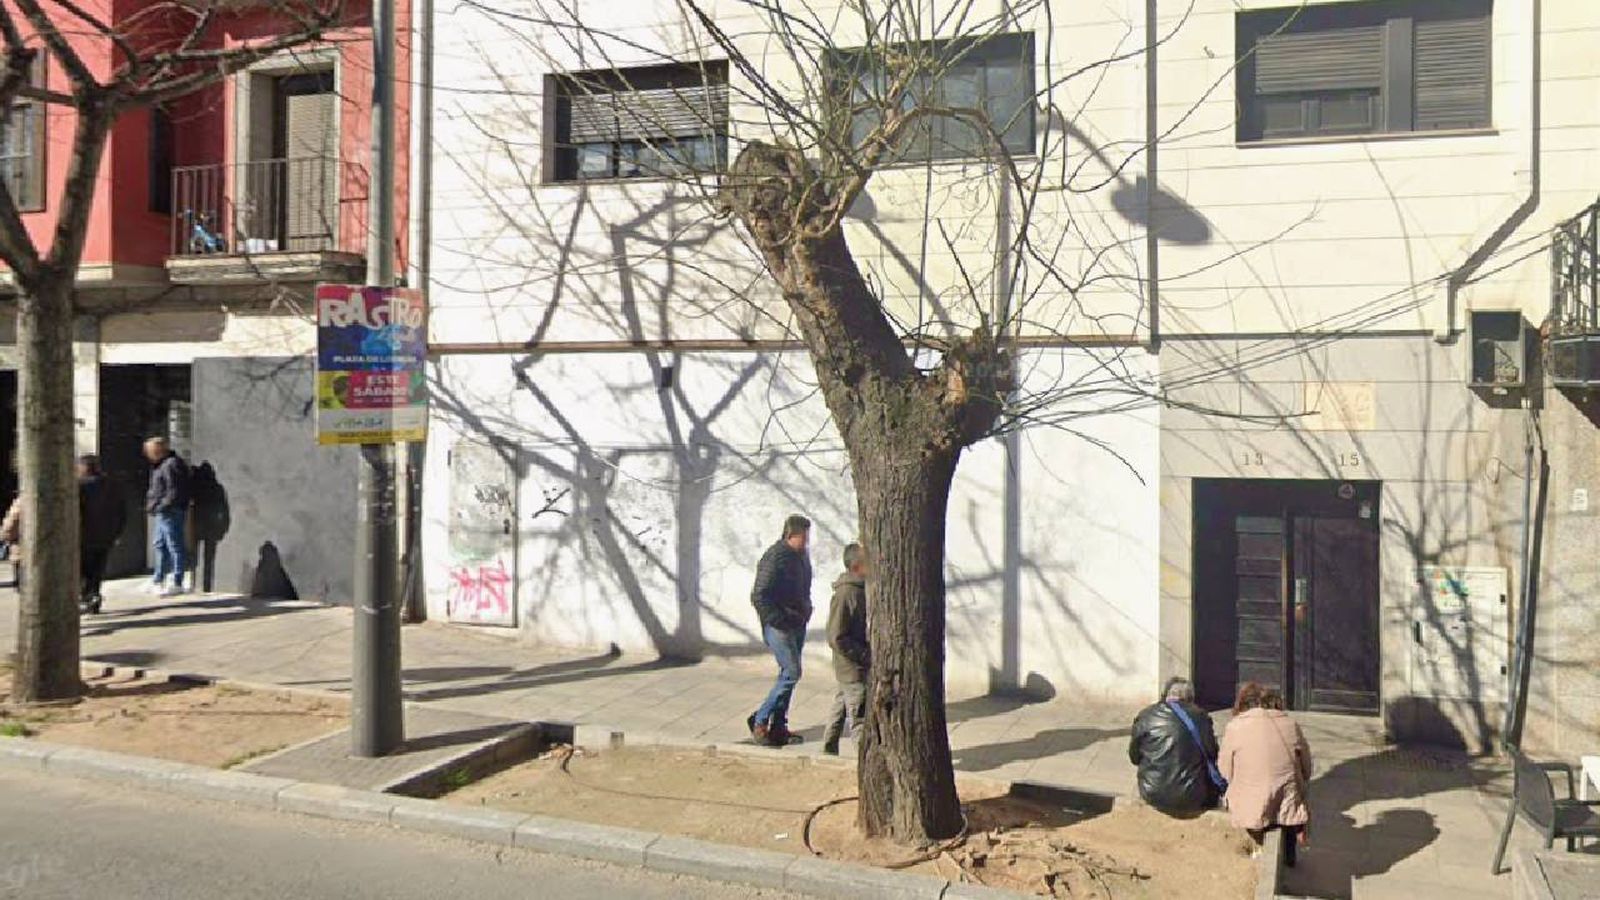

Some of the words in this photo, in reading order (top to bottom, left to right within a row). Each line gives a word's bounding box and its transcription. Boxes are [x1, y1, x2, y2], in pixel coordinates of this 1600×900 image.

[367, 375, 400, 385] ESTE
[1242, 452, 1264, 466] 13
[1340, 452, 1360, 467] 15
